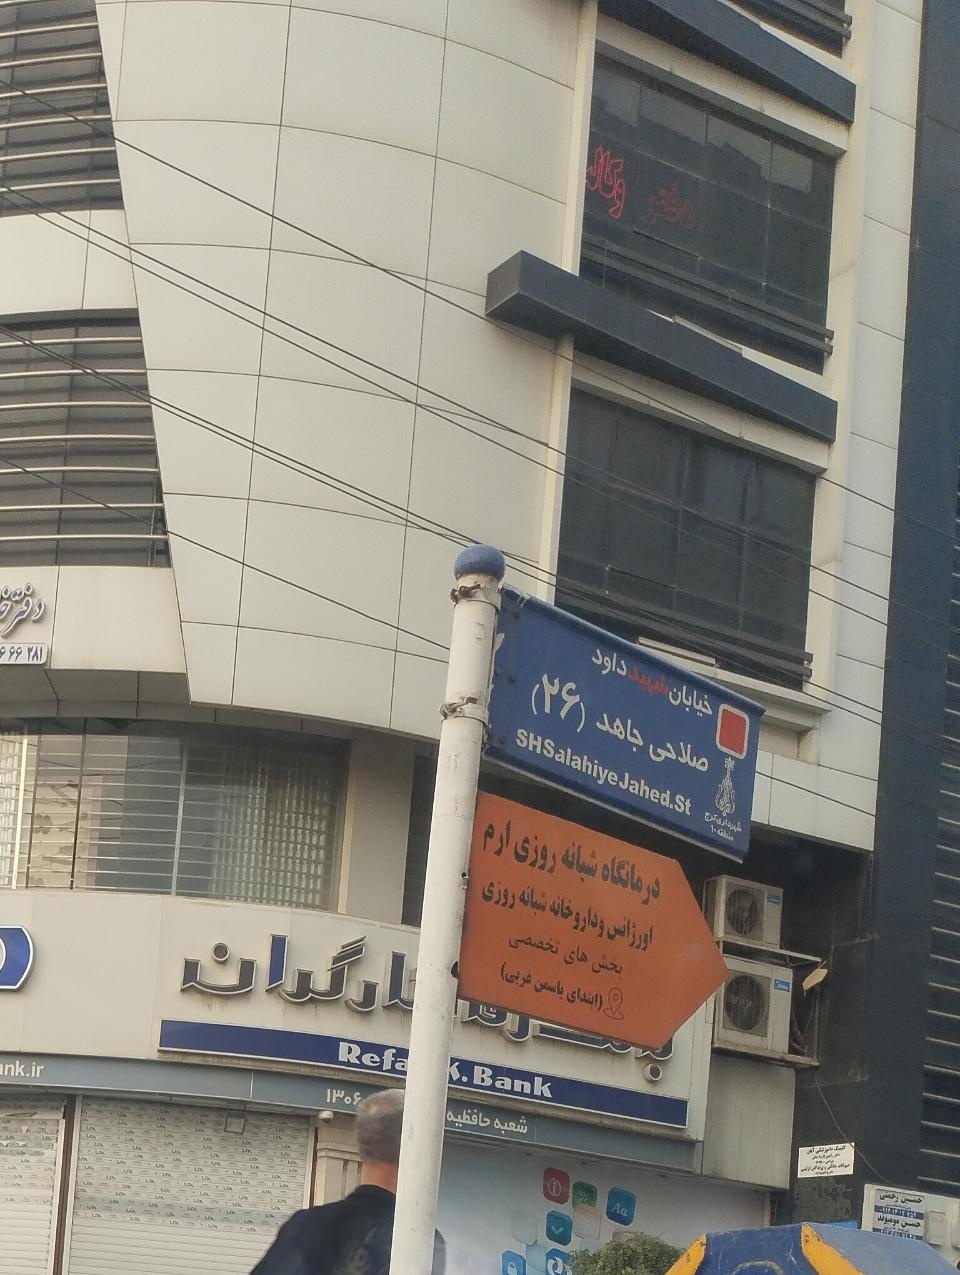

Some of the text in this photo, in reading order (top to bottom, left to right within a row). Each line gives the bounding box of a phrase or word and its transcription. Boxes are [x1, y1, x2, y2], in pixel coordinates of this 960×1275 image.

[591, 648, 714, 717] خیابان شهید داود
[596, 712, 644, 750] جاهد
[648, 741, 710, 773] صلاحی
[483, 819, 661, 905] درمانگاه شبانه روزی ارم
[482, 879, 515, 910] روزی
[519, 886, 546, 916] شبانه
[607, 918, 653, 951] اورژانس
[180, 933, 415, 1012] ارگران
[508, 933, 623, 979] بخش های تخصصی
[534, 980, 564, 997] یاسمن
[338, 1041, 408, 1072] Refa
[473, 1065, 552, 1099] Bank
[446, 1106, 491, 1128] حافظیه
[493, 1115, 529, 1135] شعبه
